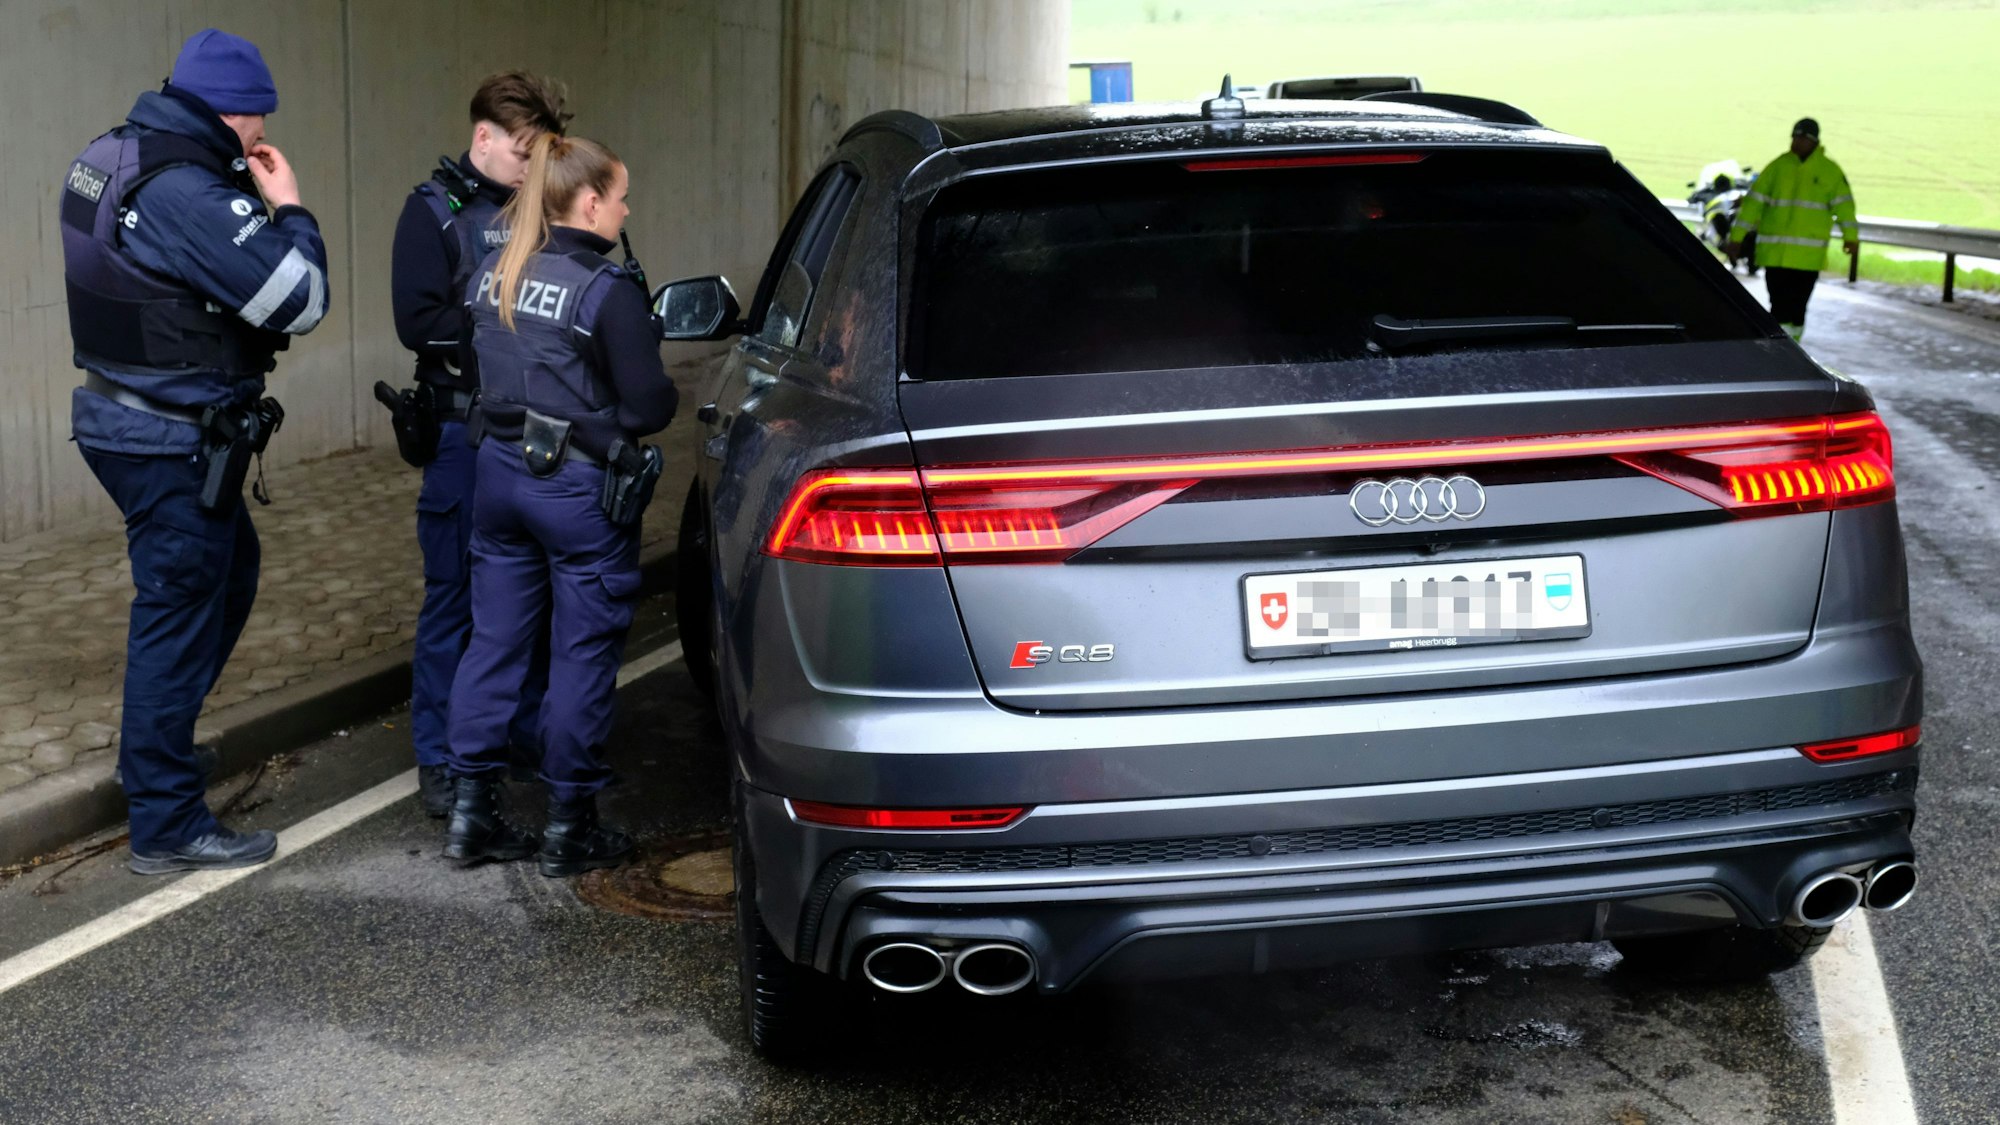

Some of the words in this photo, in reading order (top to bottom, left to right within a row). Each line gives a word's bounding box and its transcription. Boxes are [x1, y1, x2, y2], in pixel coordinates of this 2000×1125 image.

[68, 162, 108, 200] Polizei
[476, 271, 568, 320] POIZEI
[1415, 637, 1457, 647] Heerbrugg
